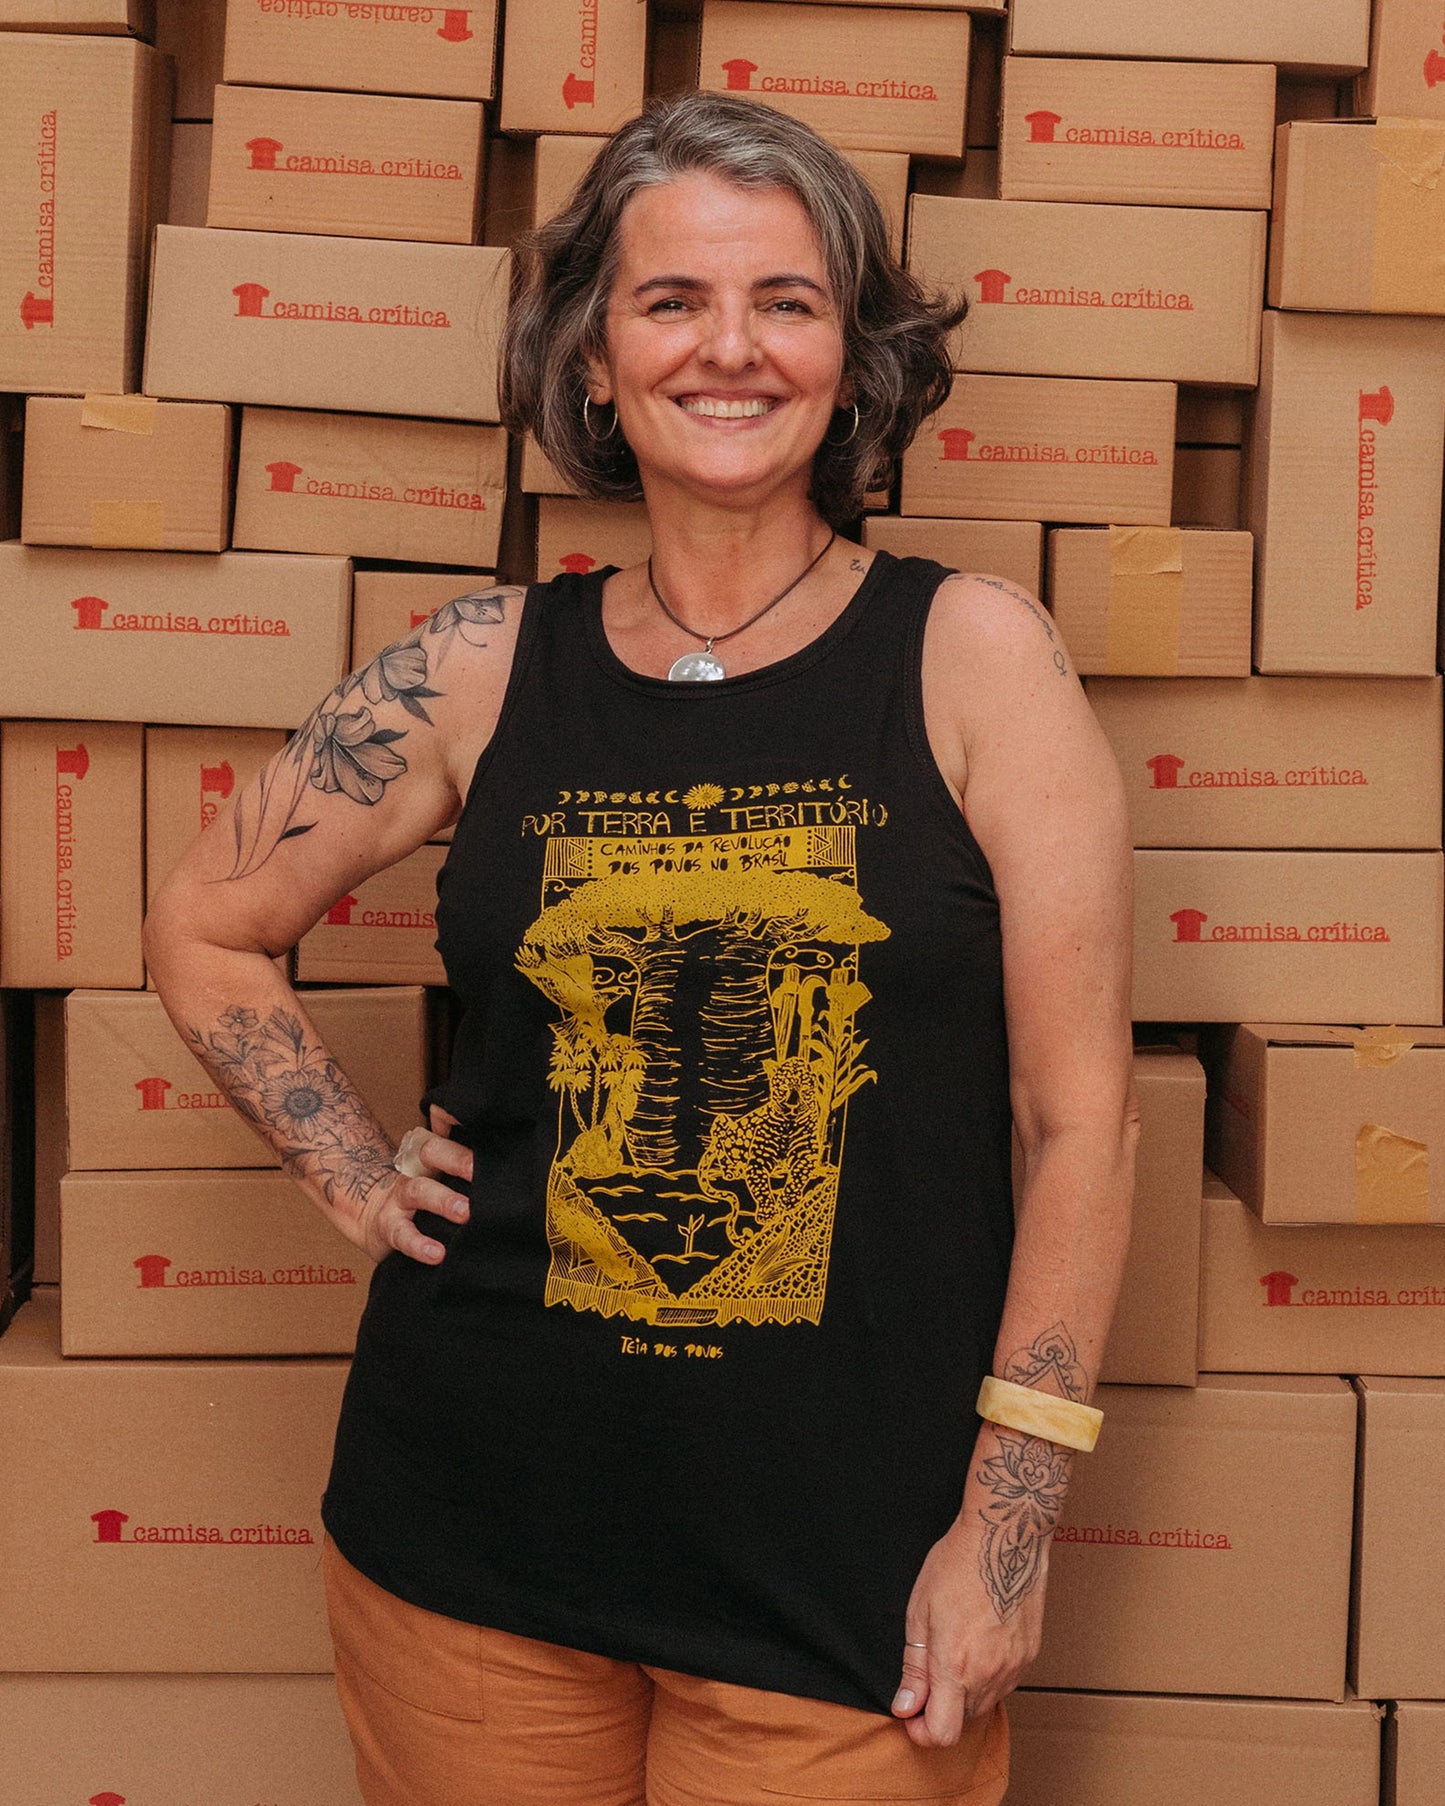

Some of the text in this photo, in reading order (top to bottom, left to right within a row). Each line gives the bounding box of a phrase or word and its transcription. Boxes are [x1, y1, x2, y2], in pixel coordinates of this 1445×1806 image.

[342, 4, 434, 24] camisa
[579, 0, 597, 69] camis
[761, 76, 937, 101] camisa crítica
[1065, 127, 1245, 151] camisa crítica
[283, 156, 462, 181] camisa crítica
[36, 109, 58, 289] camisa crítica
[1015, 287, 1194, 311] camisa crítica
[271, 301, 450, 328] camisa crítica
[980, 444, 1157, 466] camisa crítica
[307, 480, 486, 512] camisa crítica
[1355, 428, 1379, 611] camisa crítica
[114, 612, 290, 637] camisa crítica
[1189, 767, 1368, 789] camisa crítica
[522, 795, 889, 838] POR TERRA E TERRITÓRIO
[600, 833, 792, 857] CAMINHOS DA REVOLUÇÃO
[55, 784, 77, 961] camisa crítica
[608, 849, 789, 875] DOS POVOS NO BRASIL
[362, 909, 435, 928] camis
[1213, 922, 1390, 944] camisa crítica
[178, 1092, 228, 1109] cam
[176, 1265, 355, 1288] camisa crítica
[1302, 1287, 1445, 1307] camisa críti
[620, 1335, 725, 1359] TEIA DOS POVOS
[134, 1523, 314, 1546] camisa crítica
[1053, 1524, 1231, 1550] camisa crítica
